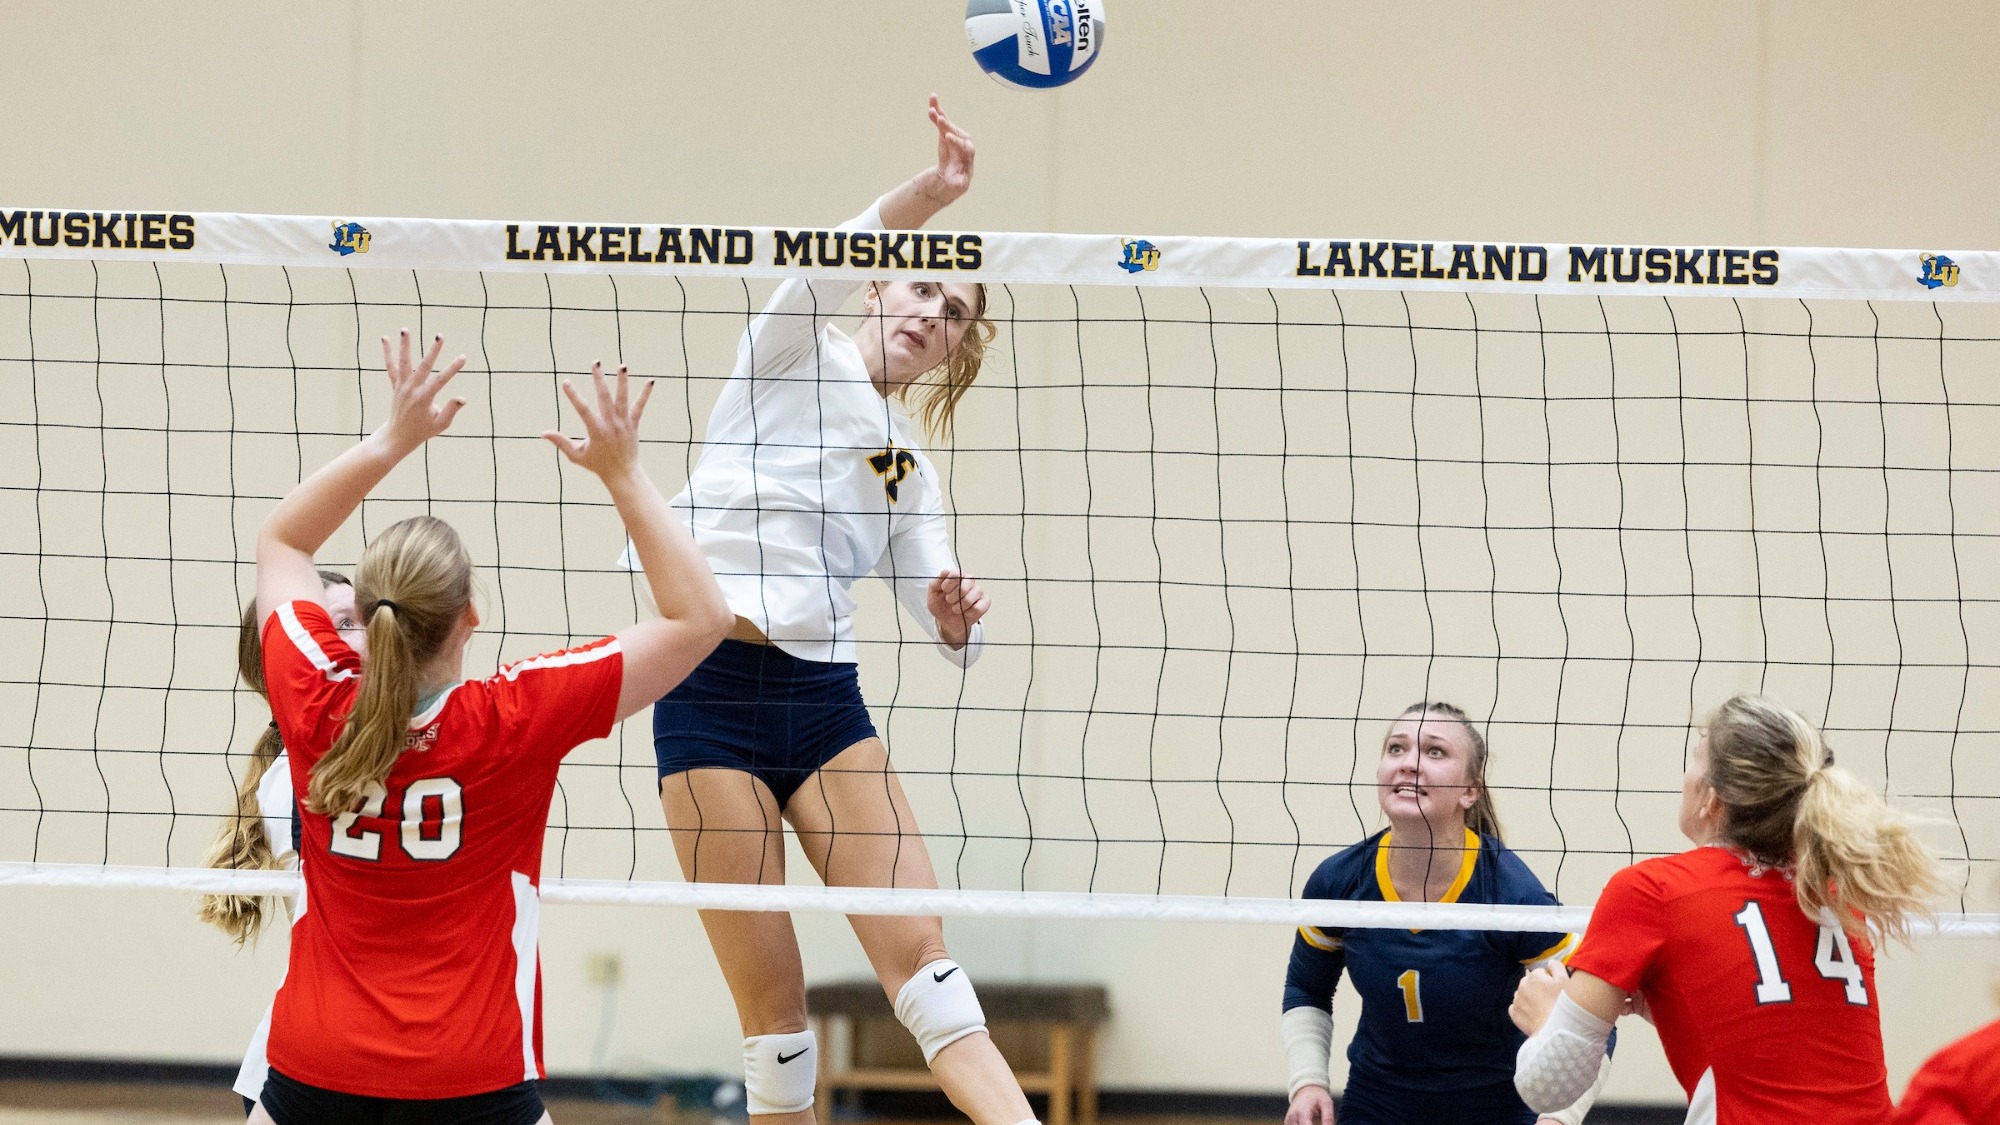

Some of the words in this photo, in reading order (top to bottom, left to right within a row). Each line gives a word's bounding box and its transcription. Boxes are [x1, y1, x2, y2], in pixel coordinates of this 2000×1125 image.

[1022, 21, 1040, 57] Touch
[1047, 0, 1073, 46] CAA
[0, 210, 195, 250] MUSKIES
[338, 225, 370, 254] LU
[505, 224, 754, 265] LAKELAND
[773, 230, 983, 270] MUSKIES
[1127, 243, 1159, 272] LU
[1296, 240, 1549, 282] LAKELAND
[1567, 246, 1780, 285] MUSKIES
[1927, 258, 1959, 288] LU
[330, 777, 465, 862] 20
[1732, 900, 1869, 1007] 14
[1397, 969, 1424, 1023] 1
